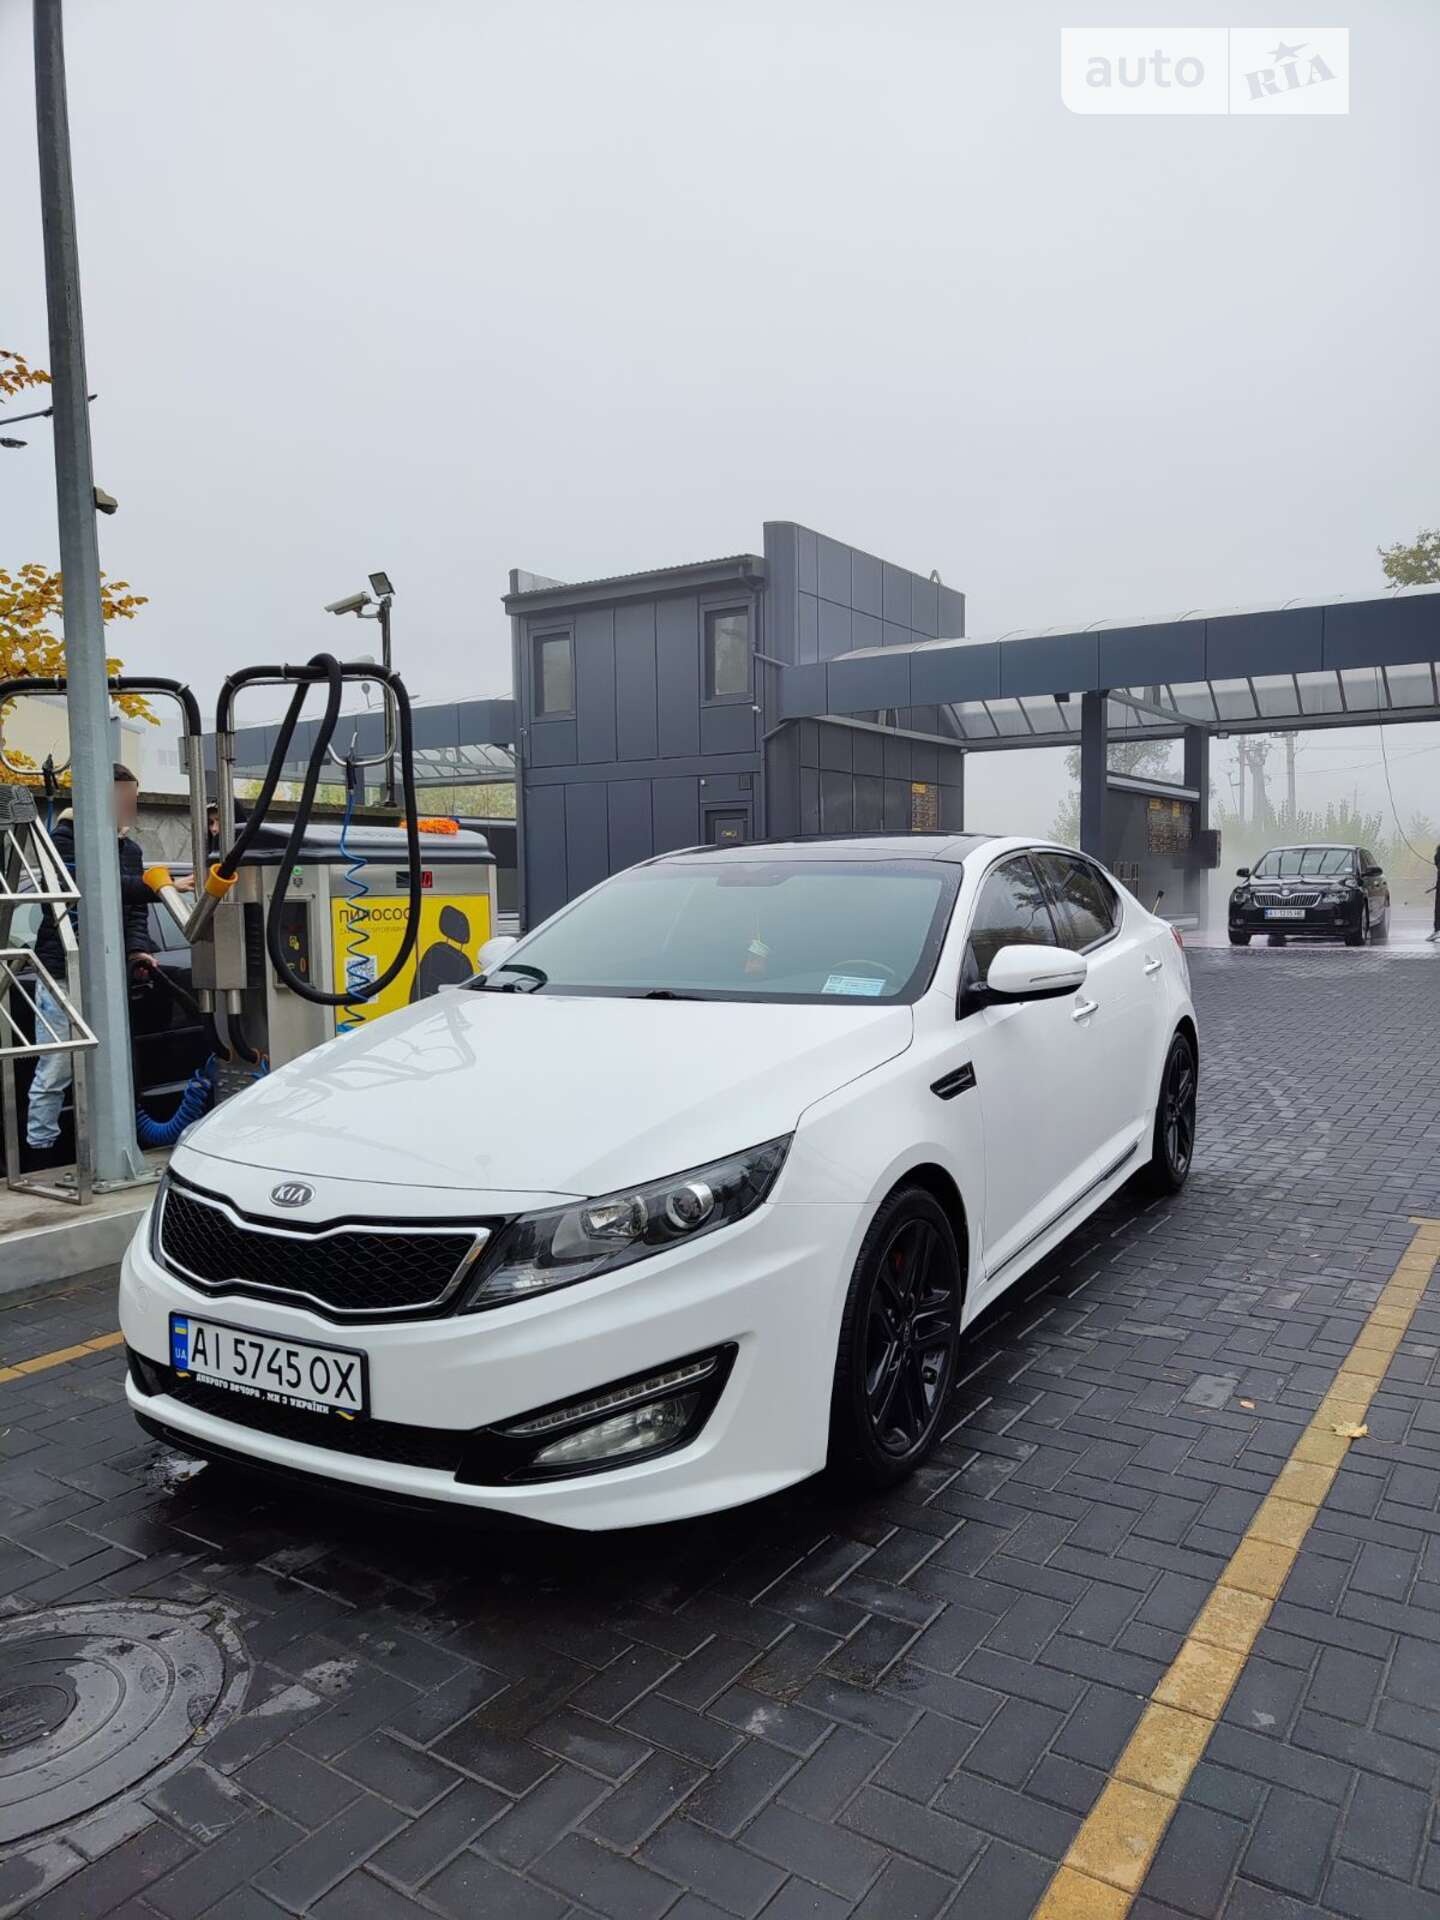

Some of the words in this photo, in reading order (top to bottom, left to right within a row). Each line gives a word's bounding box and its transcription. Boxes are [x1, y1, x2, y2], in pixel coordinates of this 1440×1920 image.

[275, 1185, 306, 1201] KIA
[175, 1349, 187, 1361] UA
[191, 1327, 220, 1370] AI
[233, 1338, 302, 1389] 5745
[309, 1356, 356, 1402] OX
